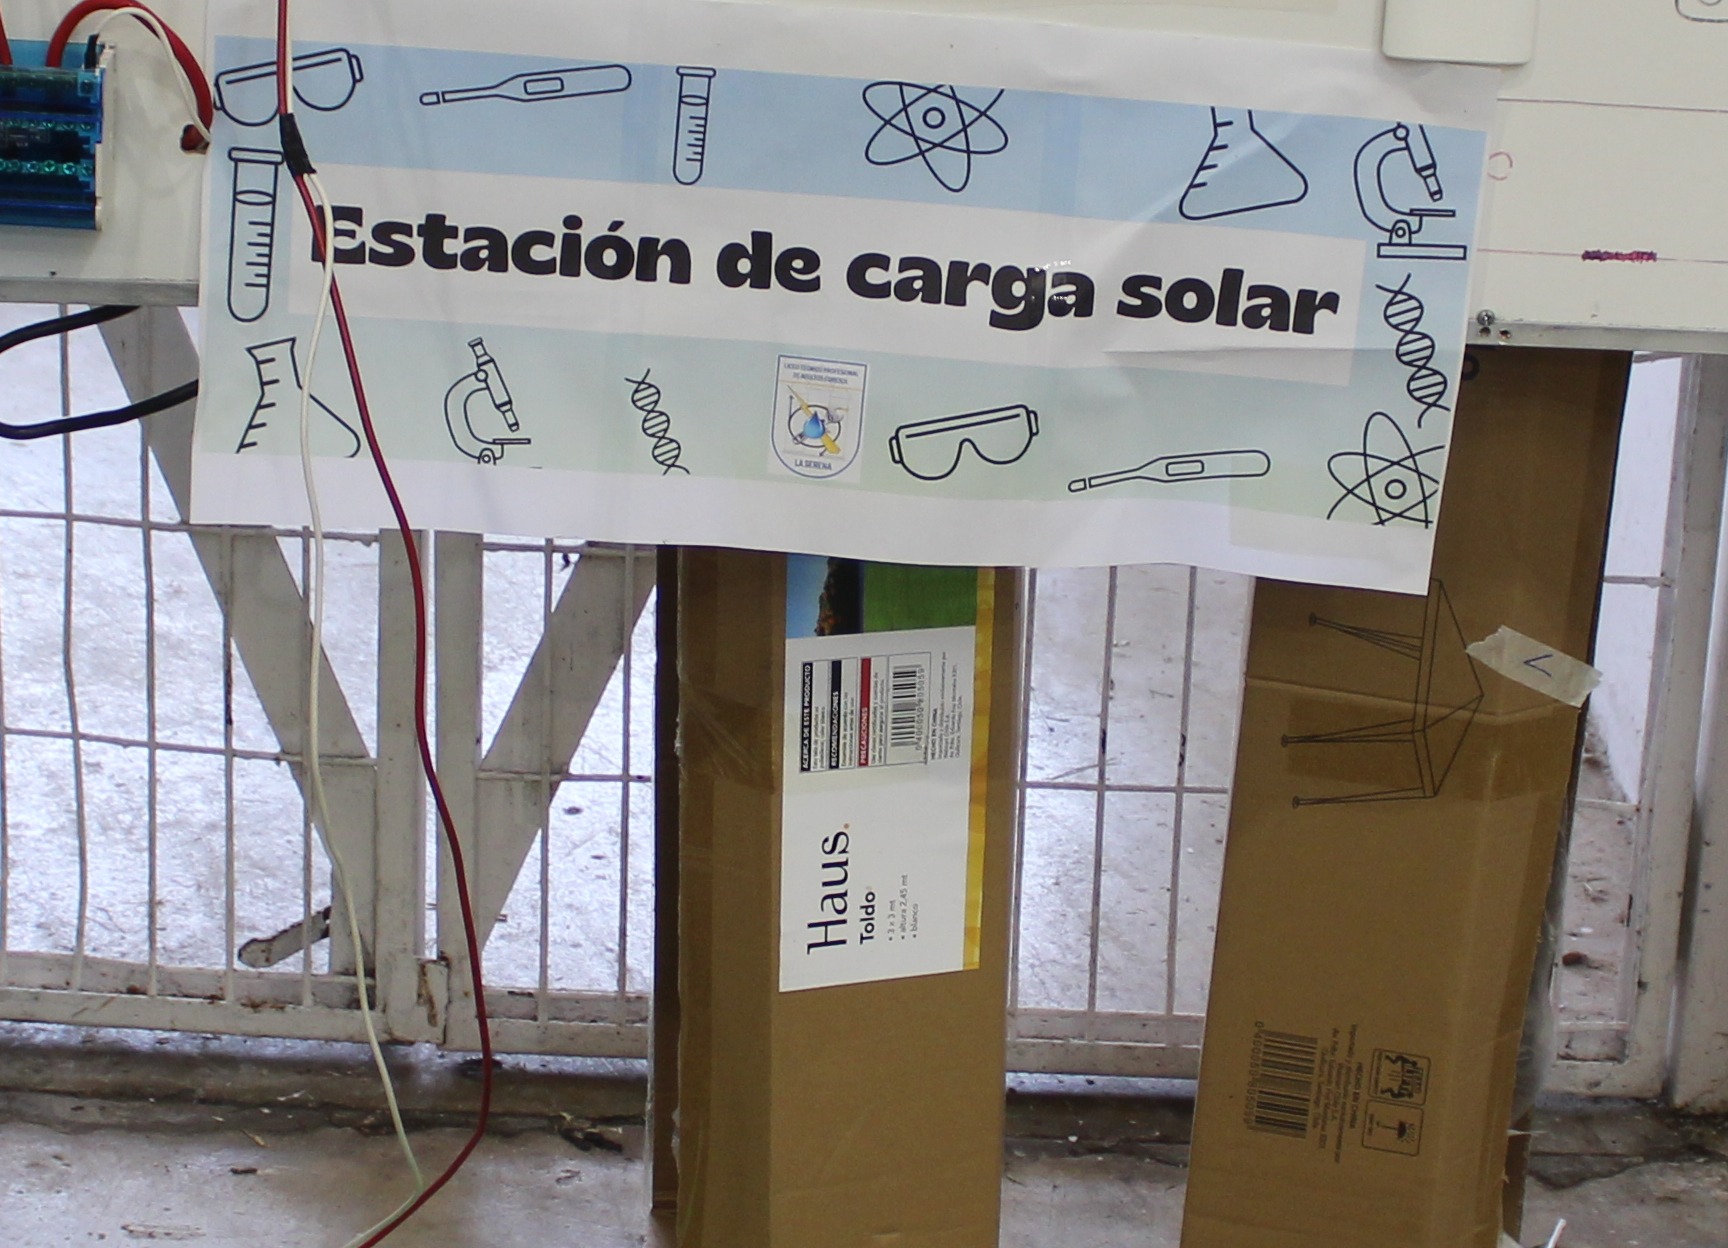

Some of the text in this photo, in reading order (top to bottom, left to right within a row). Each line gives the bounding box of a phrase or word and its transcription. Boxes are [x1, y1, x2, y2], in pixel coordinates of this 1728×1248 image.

[311, 205, 1340, 336] Estación de carga solar
[803, 664, 811, 707] PRODUCTO
[802, 738, 810, 769] ACERCA
[803, 728, 810, 738] DE
[831, 691, 839, 767] RECOMENDACIONES
[860, 707, 868, 765] PRECAUCIONES
[859, 891, 875, 945] Toldo
